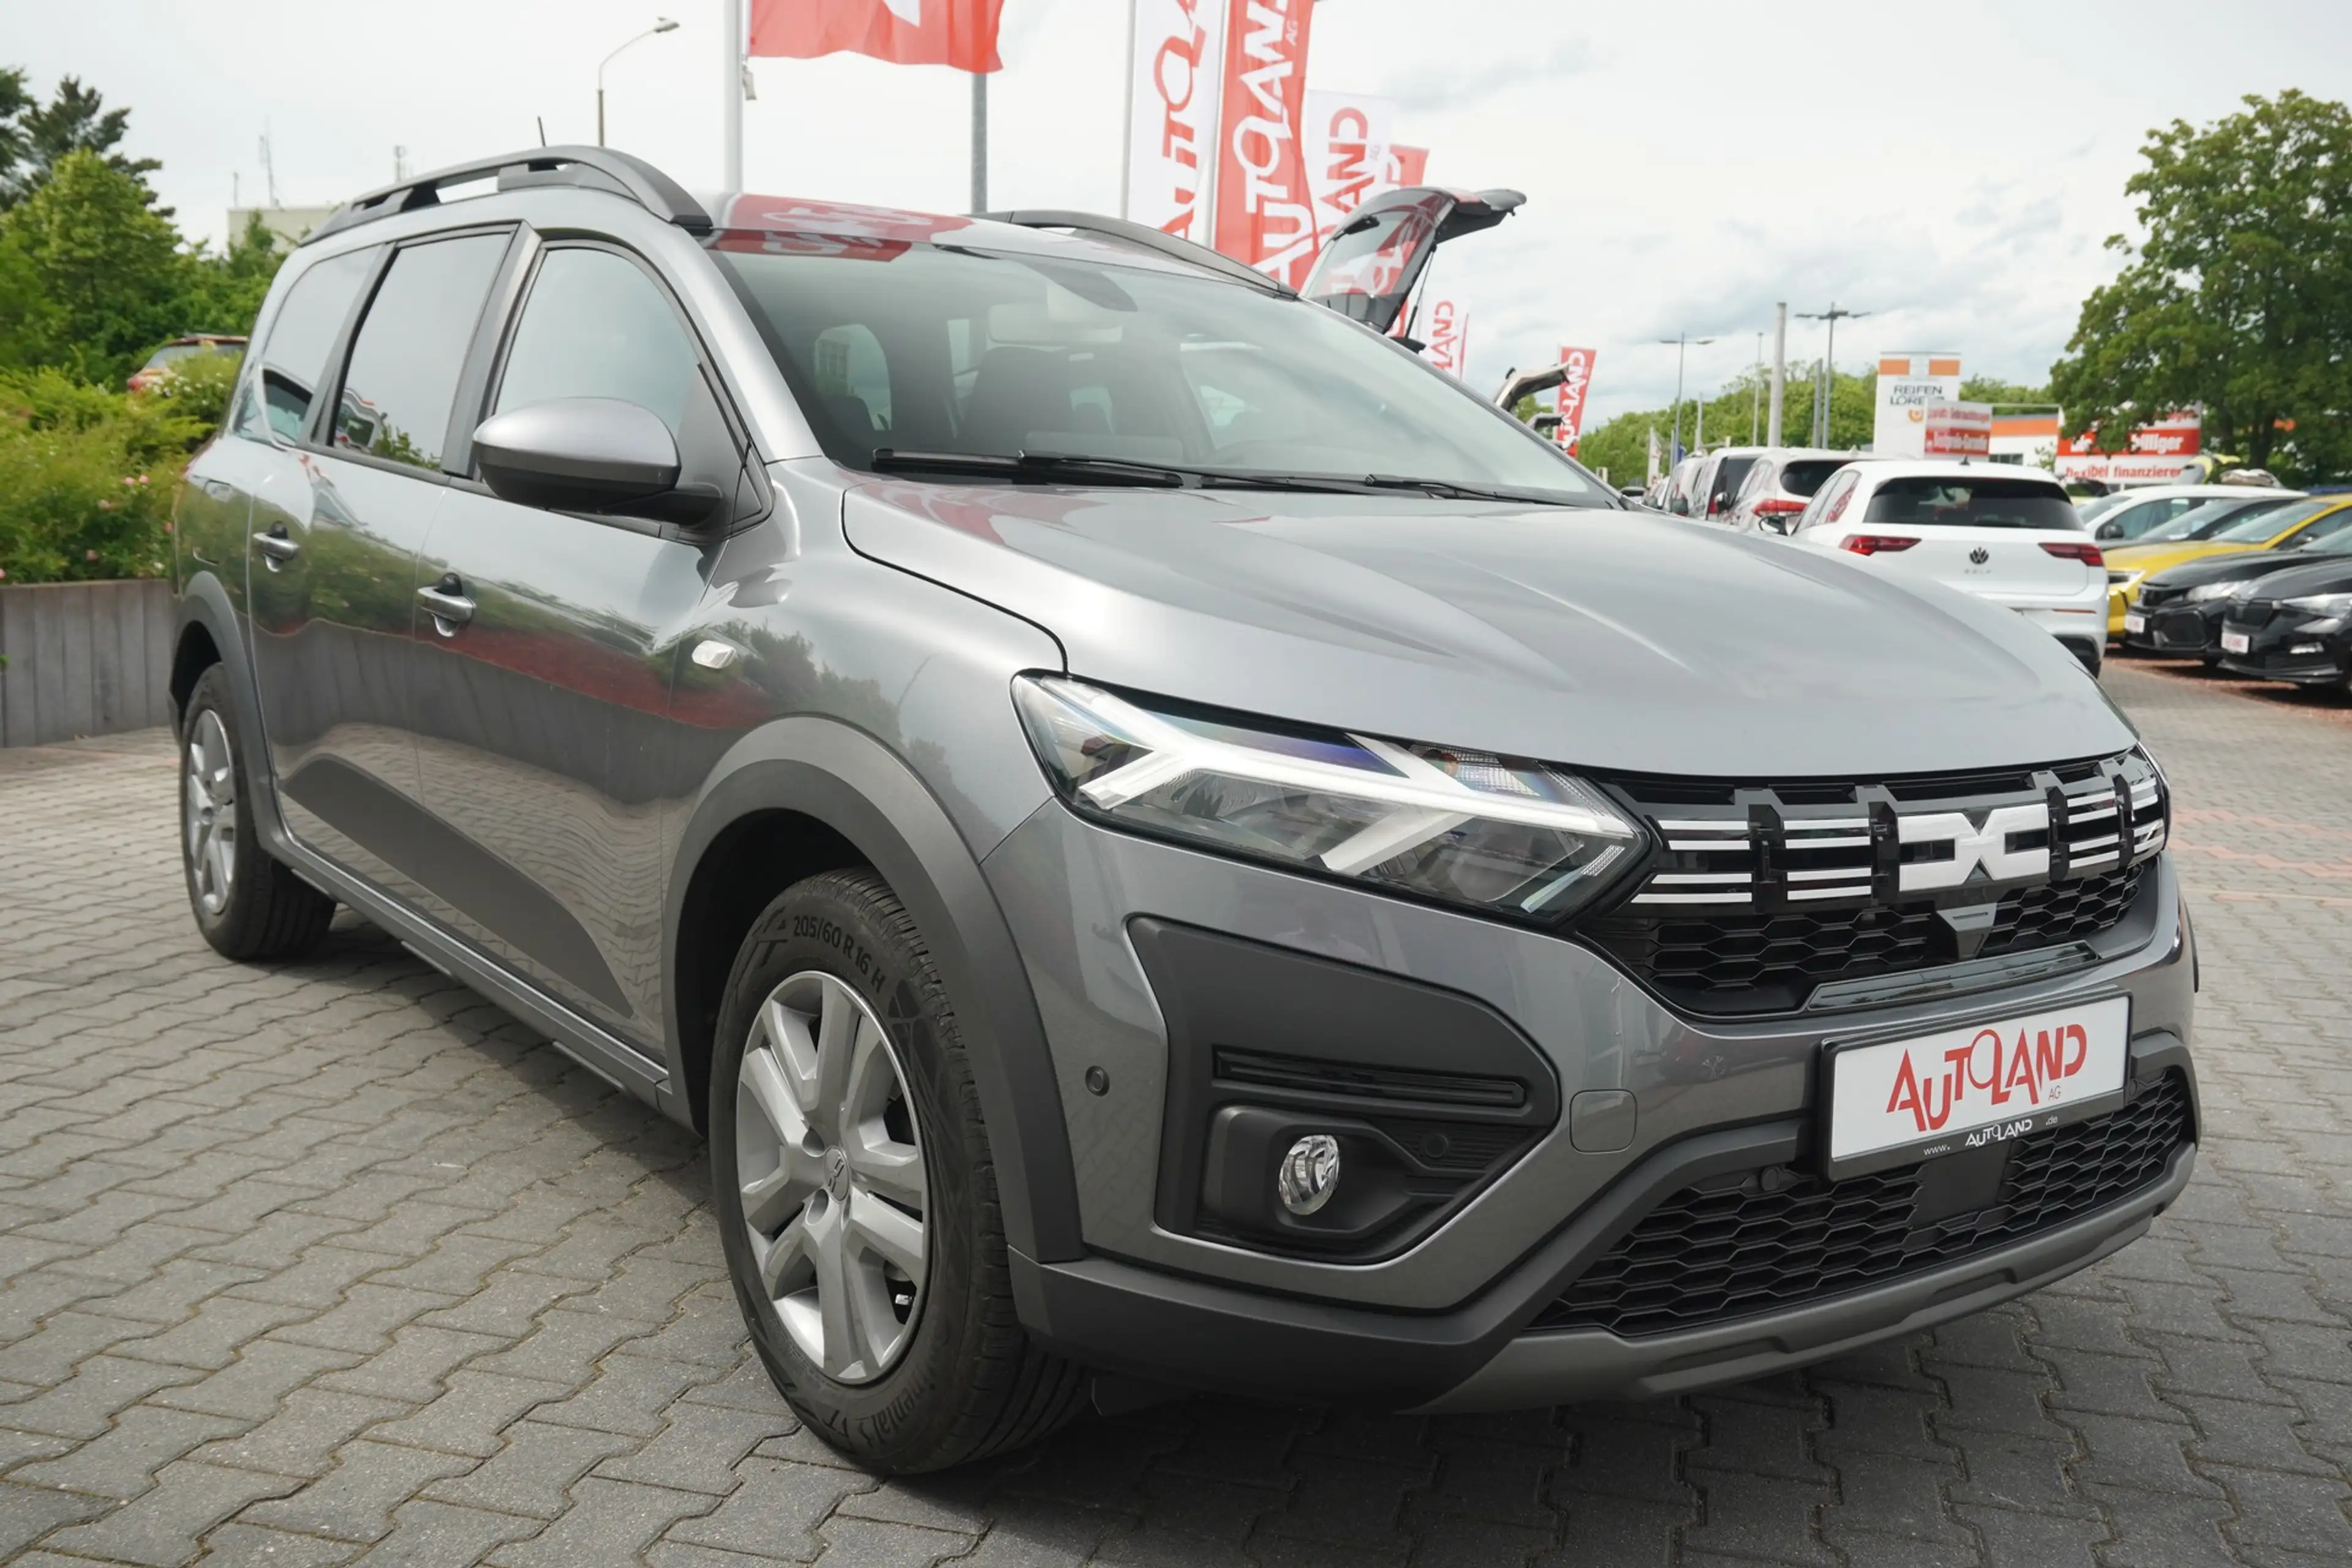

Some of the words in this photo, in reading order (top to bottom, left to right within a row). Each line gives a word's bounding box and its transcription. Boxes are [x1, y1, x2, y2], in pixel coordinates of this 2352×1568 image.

[1153, 0, 1207, 240] AUTOL
[1232, 0, 1314, 290] AUTOLAN
[1894, 385, 1942, 395] REIFEN
[793, 915, 842, 949] 205/60
[842, 934, 855, 960] R
[854, 945, 872, 976] 16
[870, 965, 887, 994] H
[2048, 1085, 2062, 1101] AG
[1923, 1144, 1951, 1156] www.
